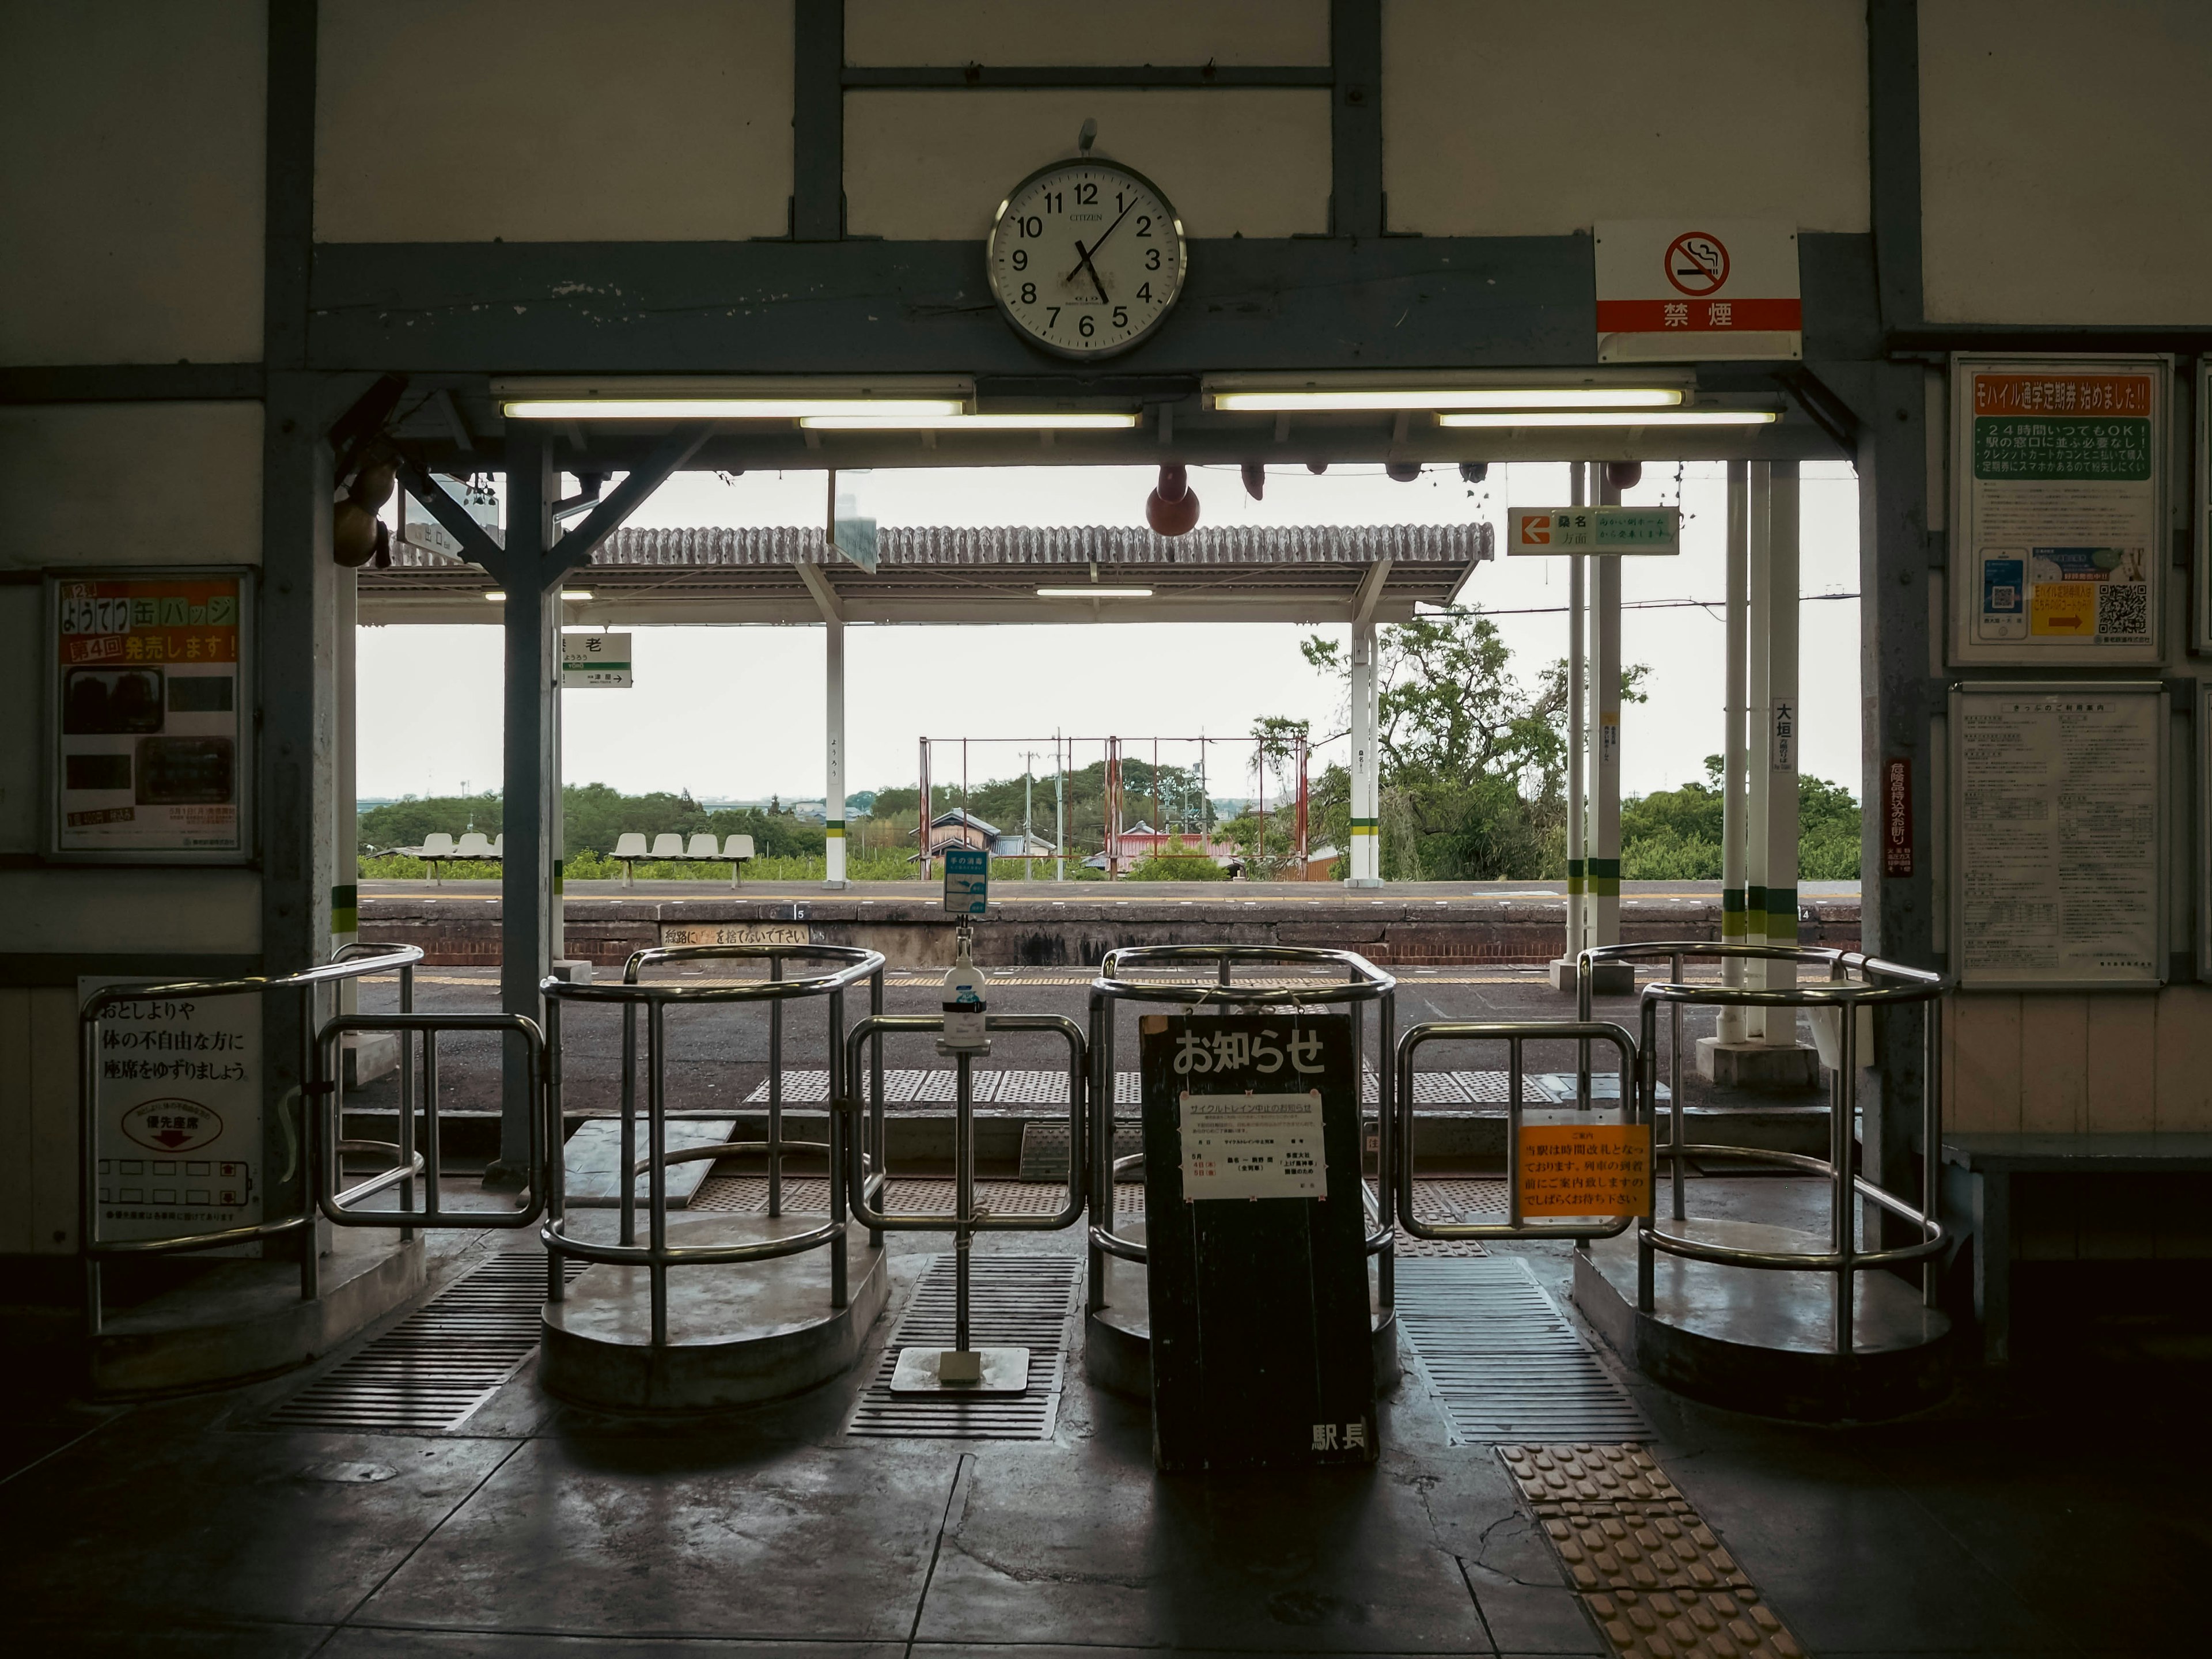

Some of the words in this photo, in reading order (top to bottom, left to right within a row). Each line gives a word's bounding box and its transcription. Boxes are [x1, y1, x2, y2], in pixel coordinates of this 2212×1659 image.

[1044, 192, 1062, 213] 11
[1074, 184, 1098, 204] 12
[1115, 192, 1123, 213] 1
[1017, 217, 1043, 238] 10
[1136, 215, 1152, 237] 2
[1012, 249, 1028, 271] 9
[1145, 249, 1160, 270] 3
[1021, 282, 1037, 304] 8
[1136, 282, 1152, 303] 4
[1046, 307, 1061, 328] 7
[1112, 306, 1128, 328] 5
[1664, 302, 1733, 327] 禁煙
[1079, 316, 1094, 337] 6
[1558, 516, 1586, 528] 桑名
[425, 527, 442, 546] 出口
[1562, 532, 1587, 545] 方面
[798, 910, 804, 919] 5
[1802, 910, 1809, 919] 4
[100, 1002, 195, 1021] おとしよりや
[102, 1029, 245, 1051] 体の不自由な方に
[1173, 1029, 1325, 1075] お知らせ
[104, 1059, 249, 1081] 座席をゆずりましょう。
[146, 1116, 199, 1130] 優先座席
[1526, 1144, 1643, 1156] 当駅は時間改札となっ
[1311, 1423, 1365, 1451] 駅長
